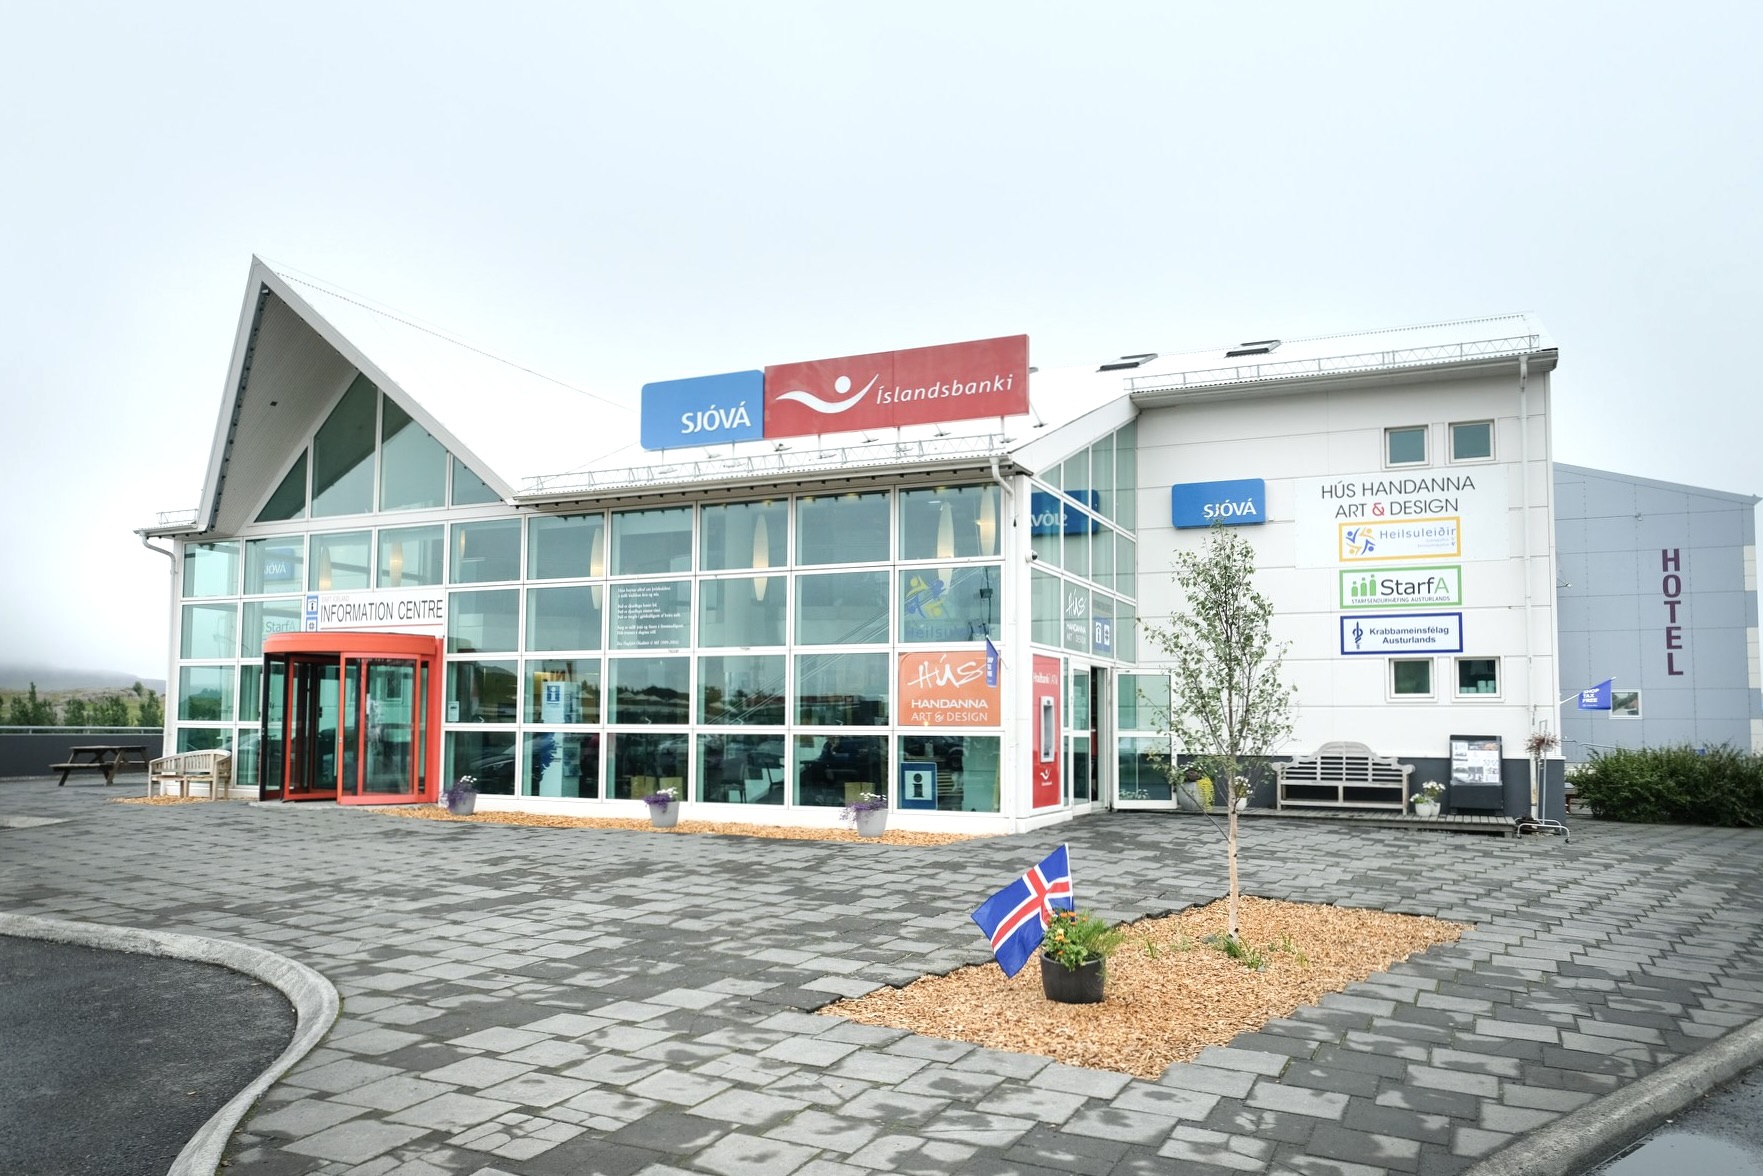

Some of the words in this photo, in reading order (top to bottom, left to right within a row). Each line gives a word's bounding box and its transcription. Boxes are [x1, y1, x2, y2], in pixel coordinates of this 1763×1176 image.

[876, 373, 1014, 405] Íslandsbanki
[681, 400, 752, 434] SJÓVÁ
[1321, 480, 1356, 499] HÚS
[1362, 475, 1476, 497] HANDANNA
[1203, 498, 1257, 518] SJÓVÁ
[1335, 503, 1368, 519] ART
[1372, 502, 1385, 517] &
[1390, 498, 1459, 516] DESIGN
[1379, 526, 1456, 539] Heilsuleiðir
[1380, 577, 1450, 596] StarfA
[320, 602, 394, 623] INFORMATION
[398, 600, 443, 620] CENTRE
[1661, 548, 1684, 676] HOTEL
[1369, 626, 1450, 635] Krabbameinsfélag
[1382, 636, 1436, 644] Austurlands
[911, 699, 989, 709] HANDANNA
[911, 712, 933, 721] ART
[946, 712, 988, 722] DESIGN
